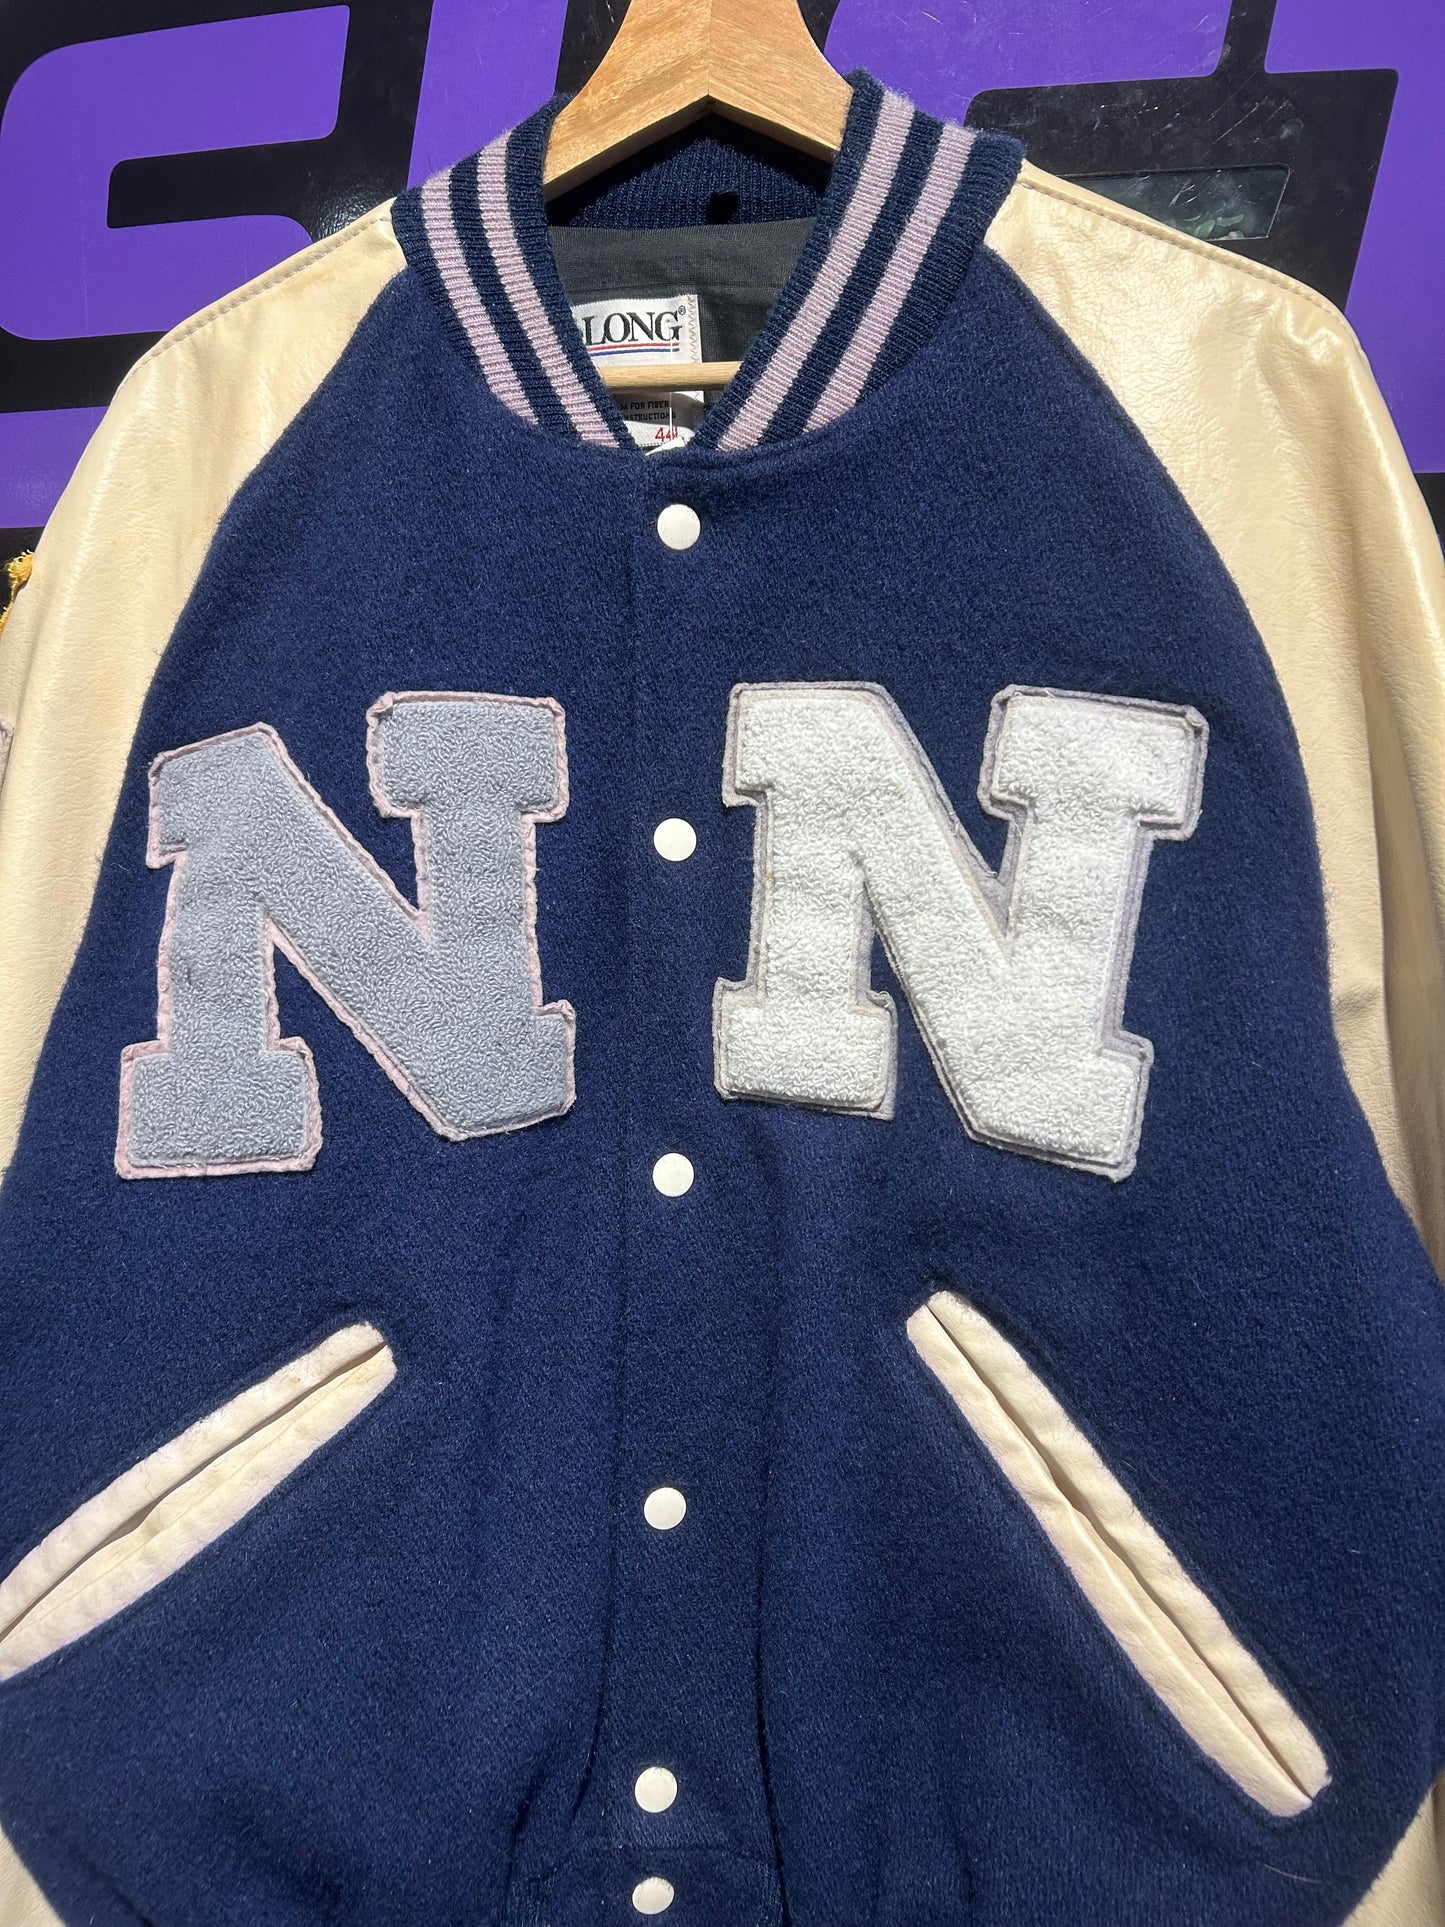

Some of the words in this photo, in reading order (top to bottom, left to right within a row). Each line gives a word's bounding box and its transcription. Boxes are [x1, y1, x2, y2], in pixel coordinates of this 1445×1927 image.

[581, 309, 683, 346] LONG
[623, 412, 676, 421] NSTRUCTIONS
[630, 402, 645, 410] FOR
[647, 400, 669, 409] FIBER
[114, 690, 577, 1181] N
[712, 681, 1209, 1181] N
